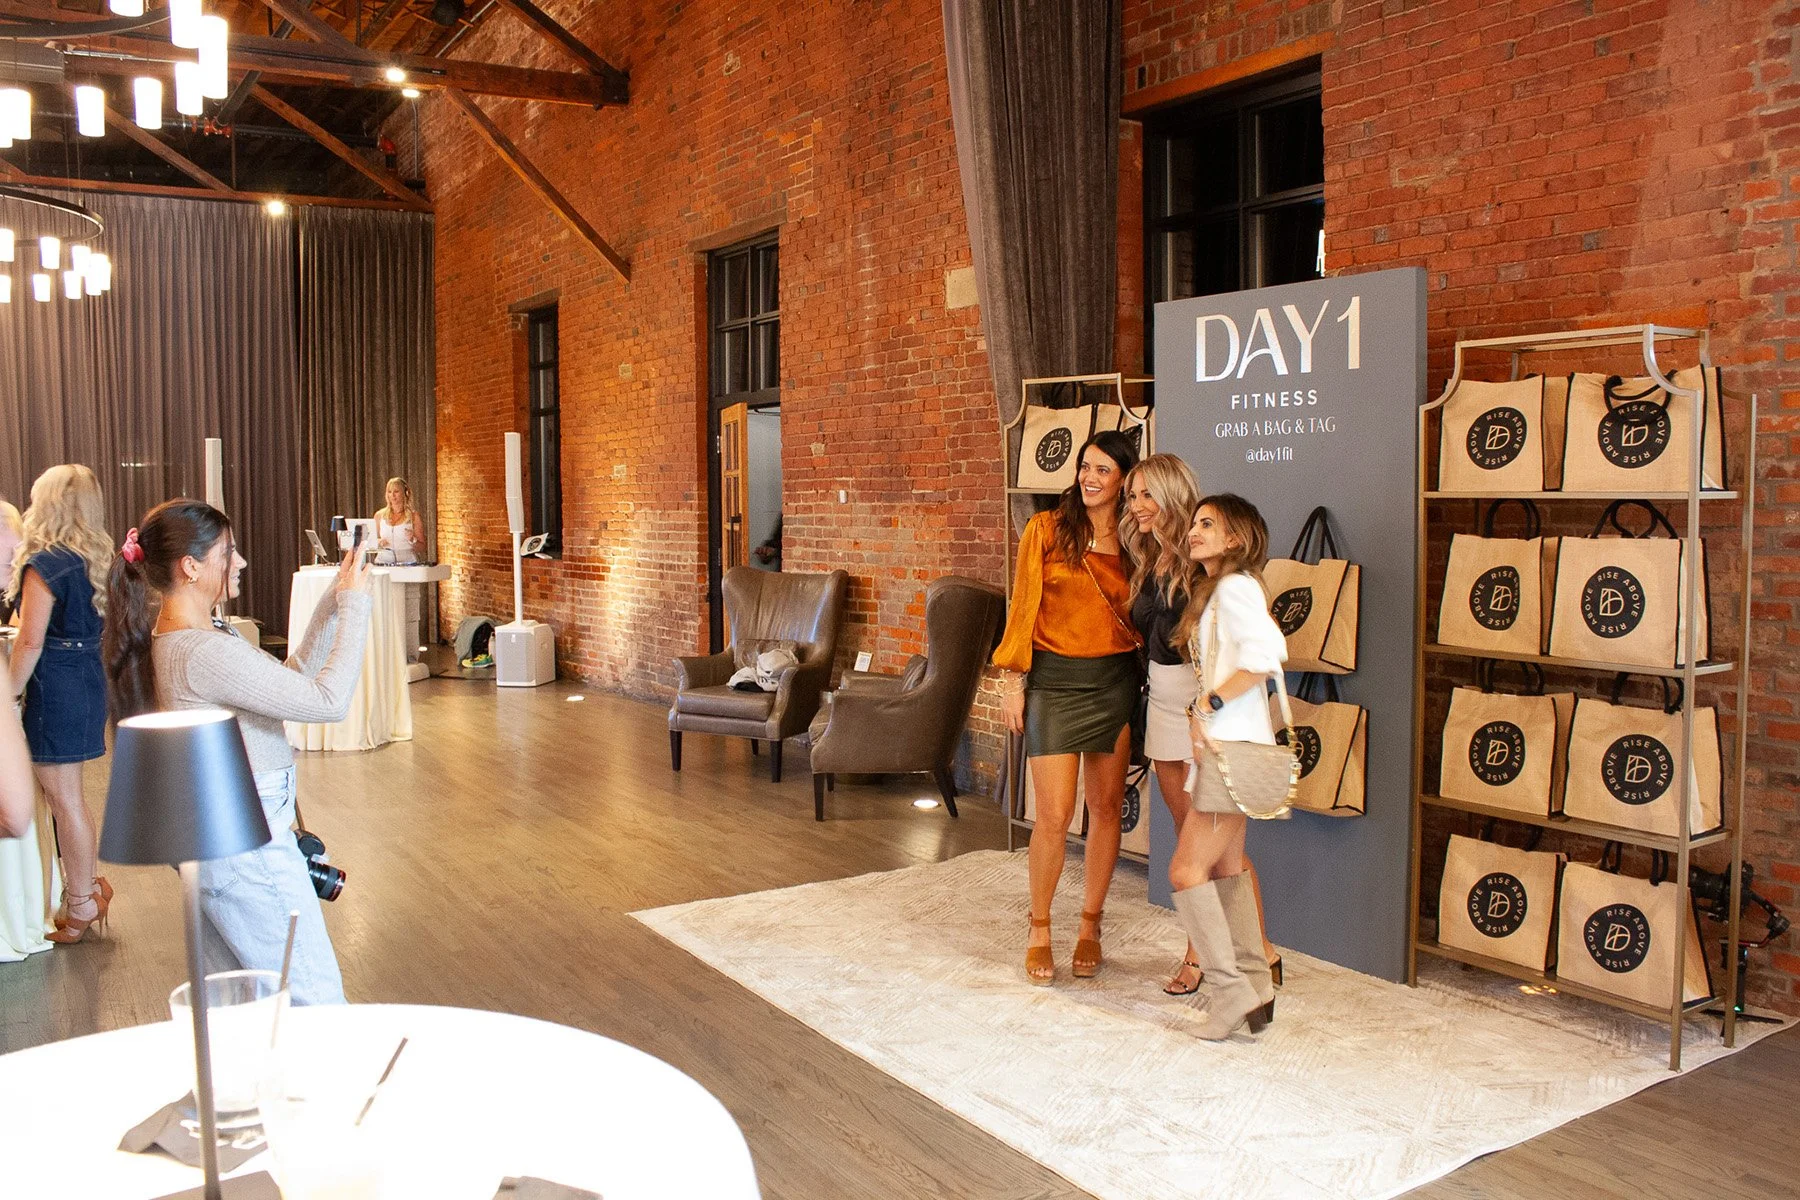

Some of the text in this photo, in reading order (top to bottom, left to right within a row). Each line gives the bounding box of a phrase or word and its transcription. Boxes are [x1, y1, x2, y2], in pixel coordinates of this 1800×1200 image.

[1231, 389, 1318, 410] FITNESS
[1618, 405, 1646, 415] RISE
[1486, 411, 1511, 421] RISE
[1215, 416, 1337, 438] GRAB A BAG & TAG
[1602, 421, 1619, 458] ABOVE
[1246, 446, 1293, 464] @day1fit
[1623, 451, 1650, 463] RISE
[1597, 571, 1619, 582] RISE
[1487, 725, 1510, 734] RISE
[1622, 739, 1650, 749] RISE
[1487, 877, 1511, 886] RISE
[1606, 908, 1632, 918] RISE
